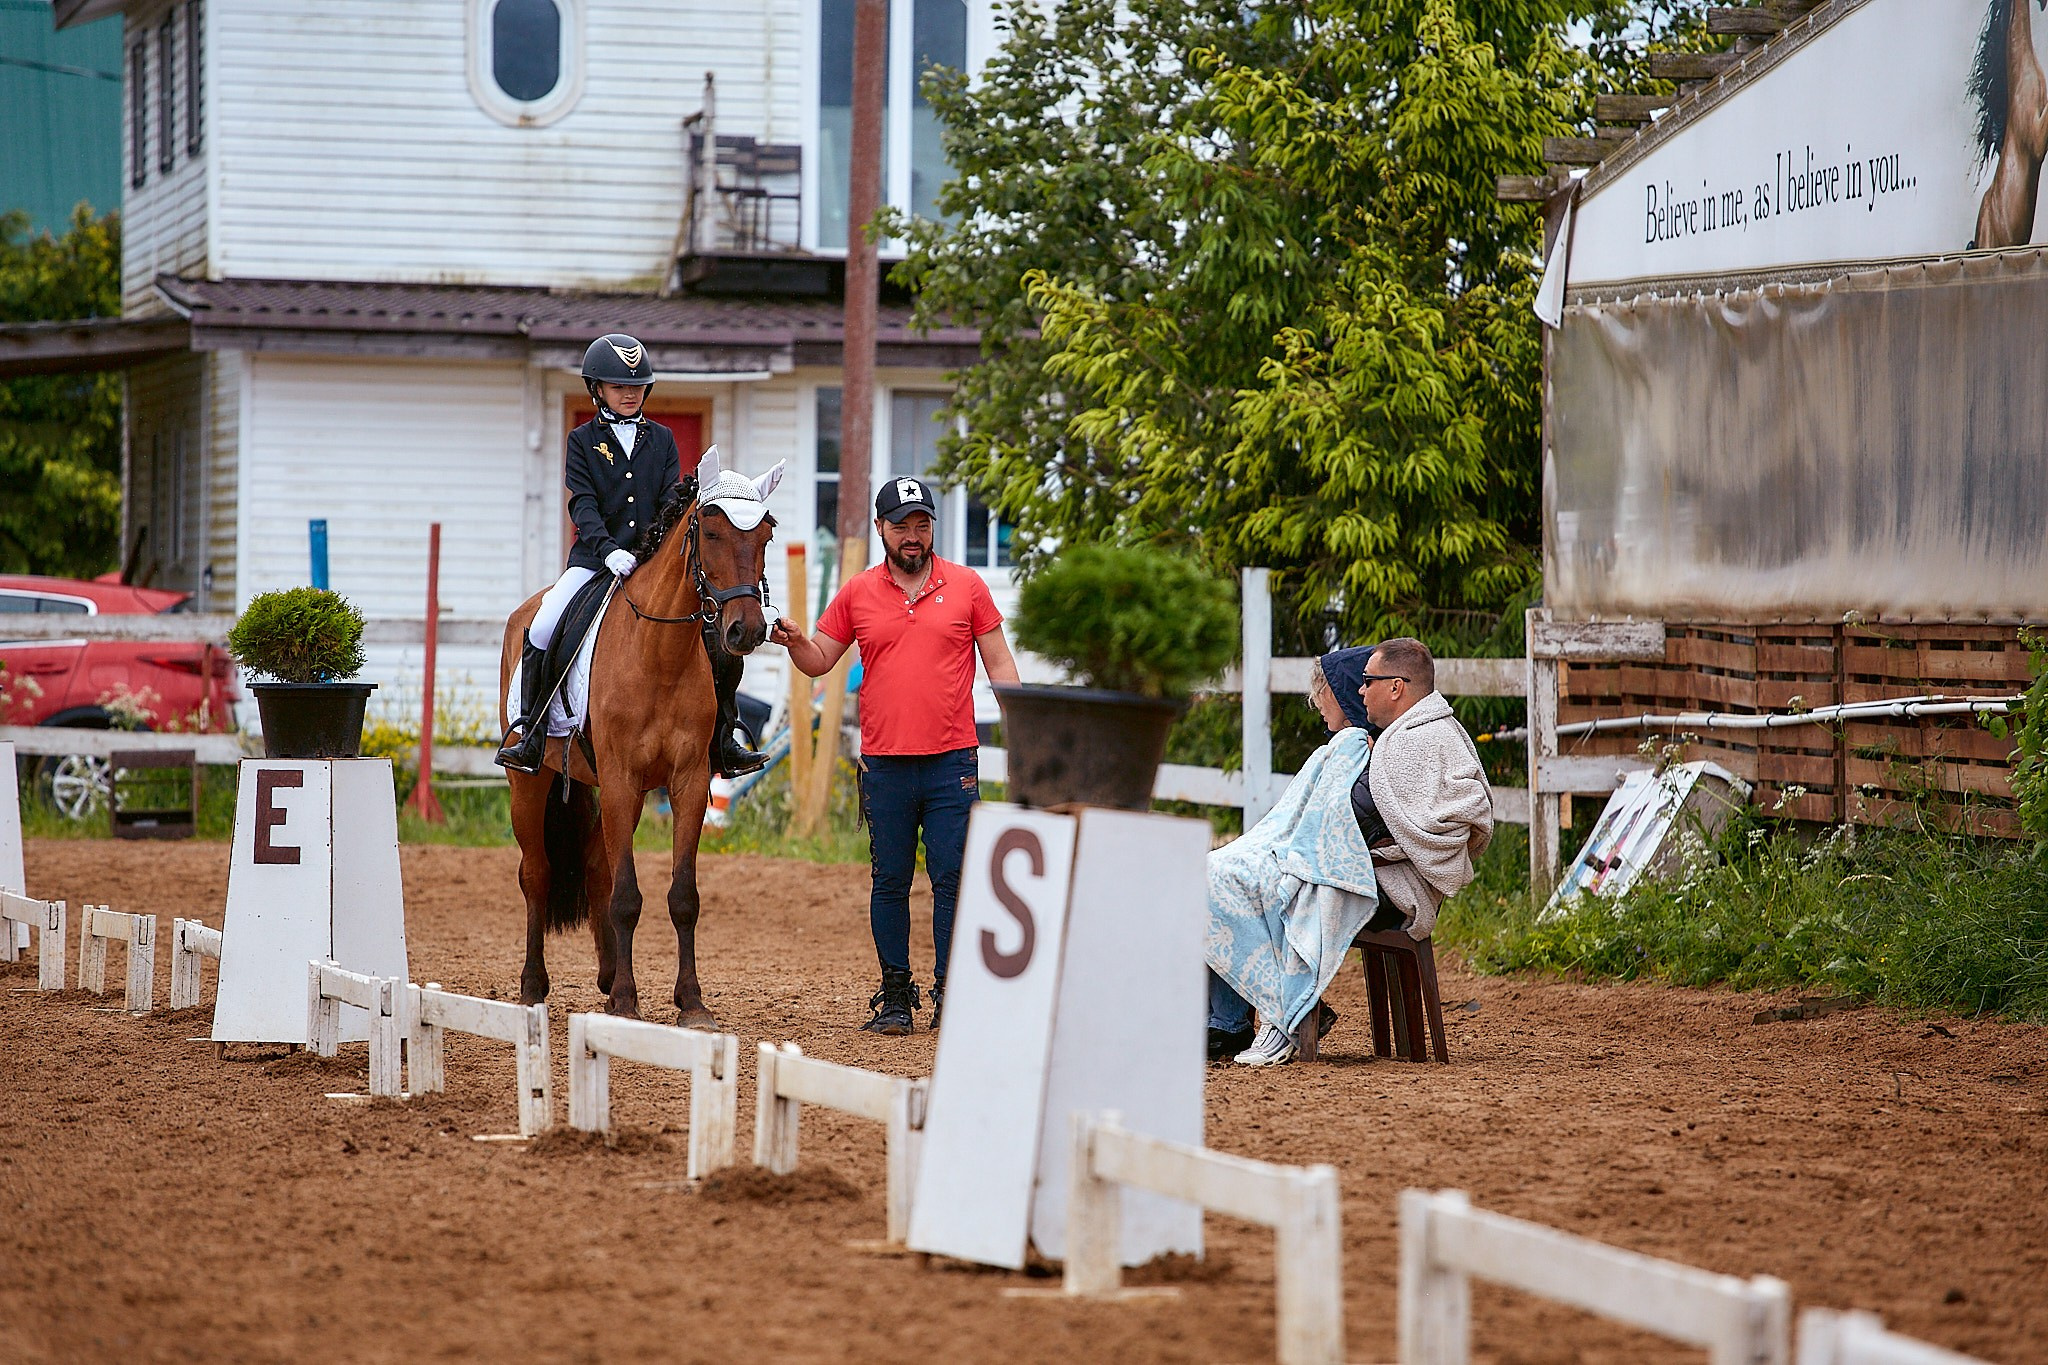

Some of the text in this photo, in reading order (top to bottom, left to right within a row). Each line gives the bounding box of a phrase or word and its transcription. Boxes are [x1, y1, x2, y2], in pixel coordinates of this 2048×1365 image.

[1645, 143, 1918, 244] Believe in me, as I believe in you...
[253, 769, 303, 864] E
[981, 828, 1044, 978] S
